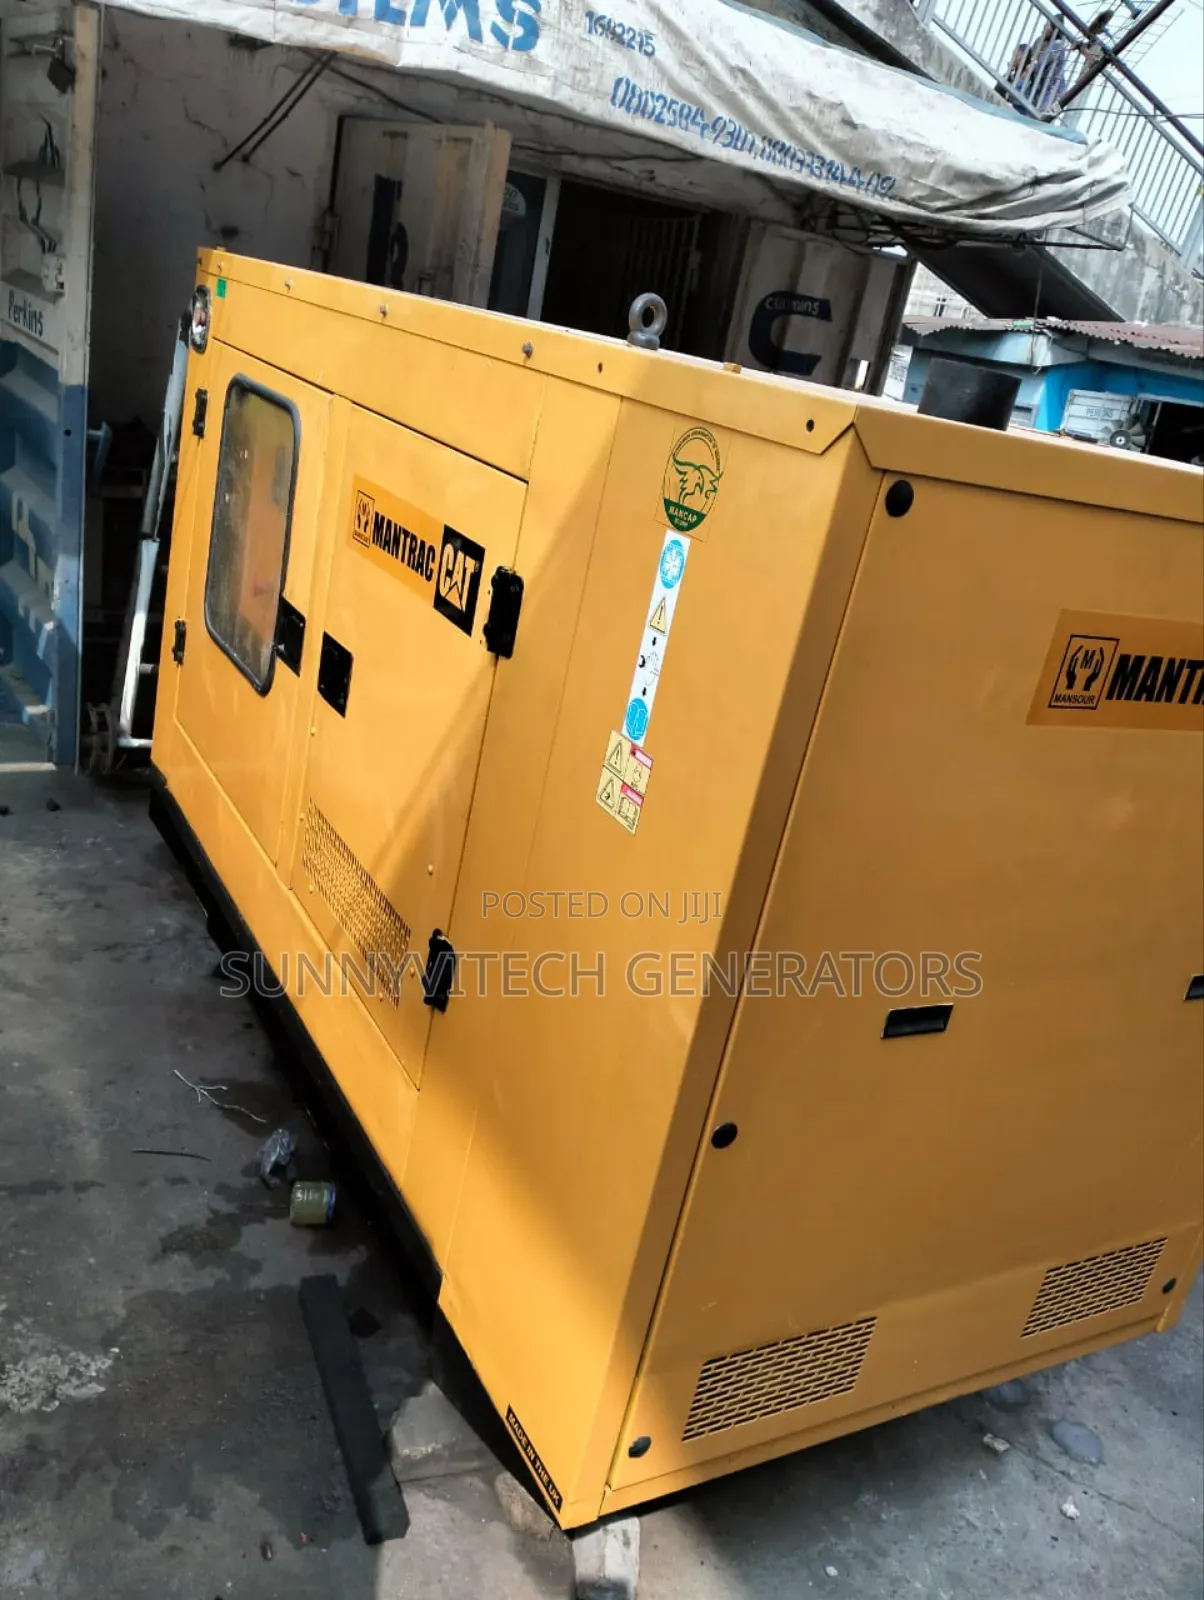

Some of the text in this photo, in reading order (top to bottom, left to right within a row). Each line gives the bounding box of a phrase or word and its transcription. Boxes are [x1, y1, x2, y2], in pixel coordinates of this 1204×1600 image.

[8, 287, 44, 338] Perkins
[372, 511, 436, 582] MANTRAC
[439, 543, 477, 613] CAT
[1053, 693, 1096, 705] MANSOUR
